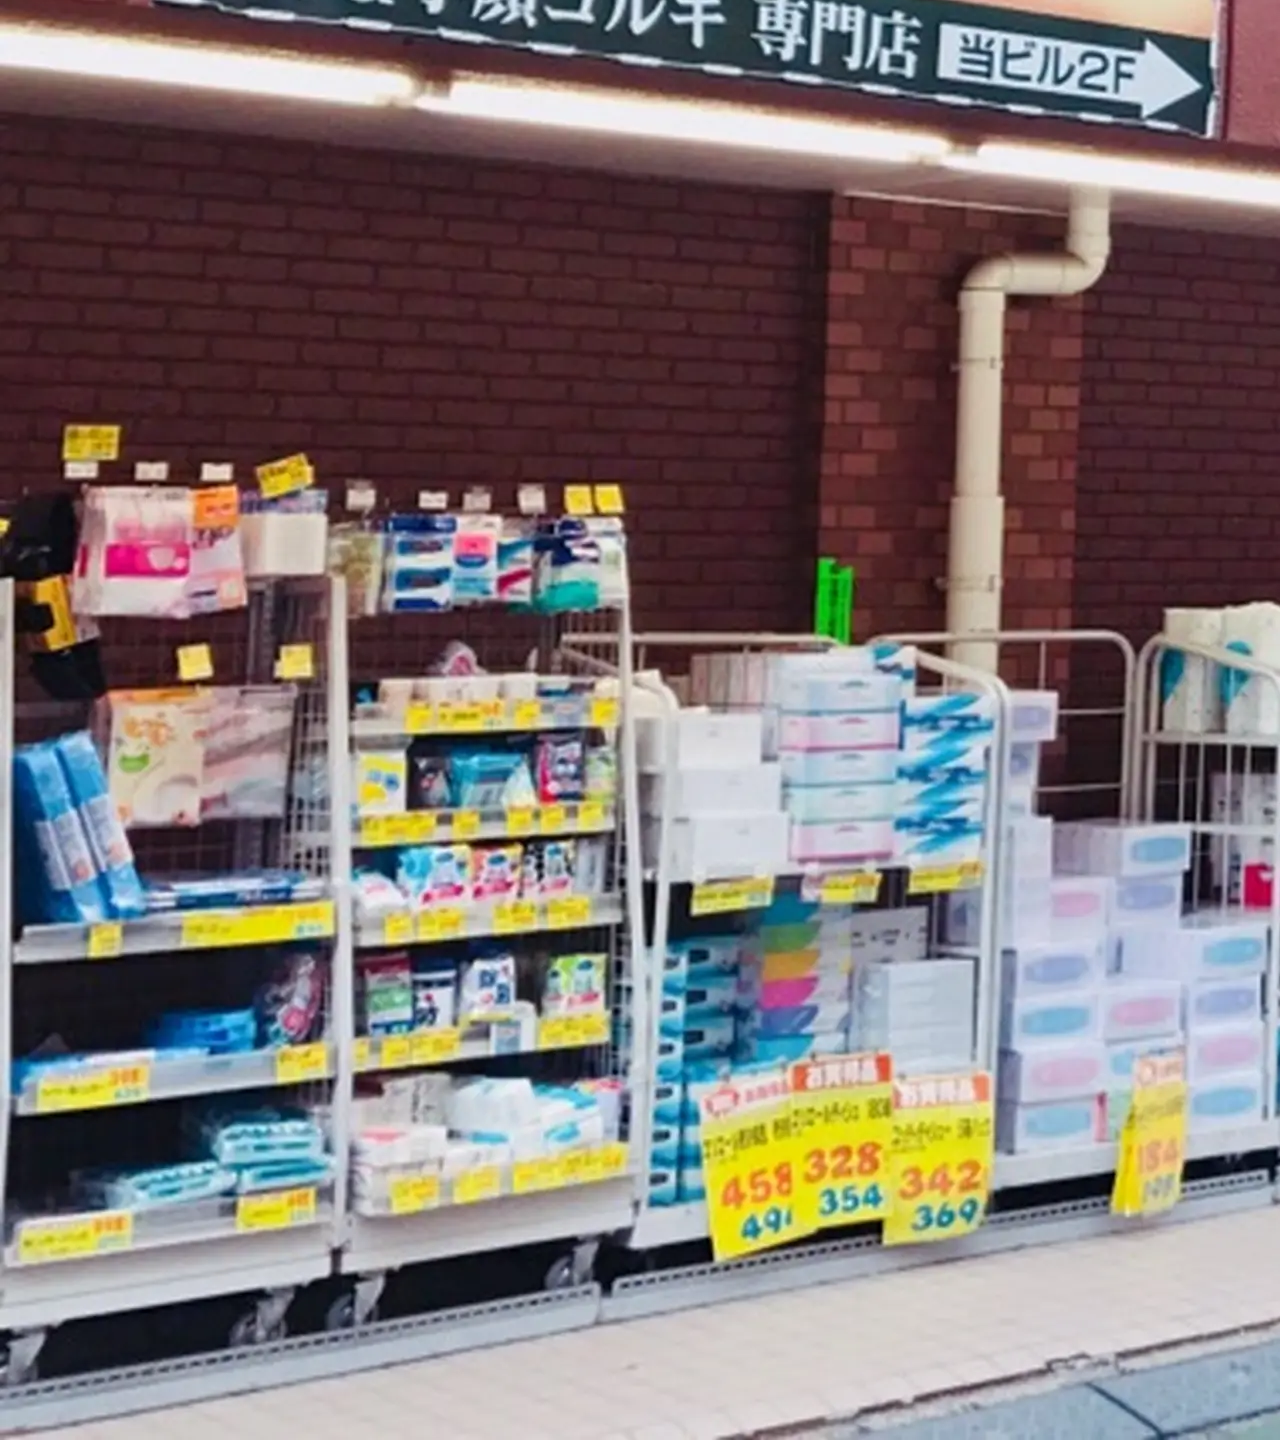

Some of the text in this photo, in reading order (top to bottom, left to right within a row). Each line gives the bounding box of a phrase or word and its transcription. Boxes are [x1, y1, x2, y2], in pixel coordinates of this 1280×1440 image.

[955, 32, 1136, 97] 当ビル2F
[803, 1142, 882, 1183] 328
[899, 1160, 981, 1200] 342
[721, 1161, 792, 1208] 458
[819, 1184, 883, 1216] 354
[912, 1198, 978, 1230] 369
